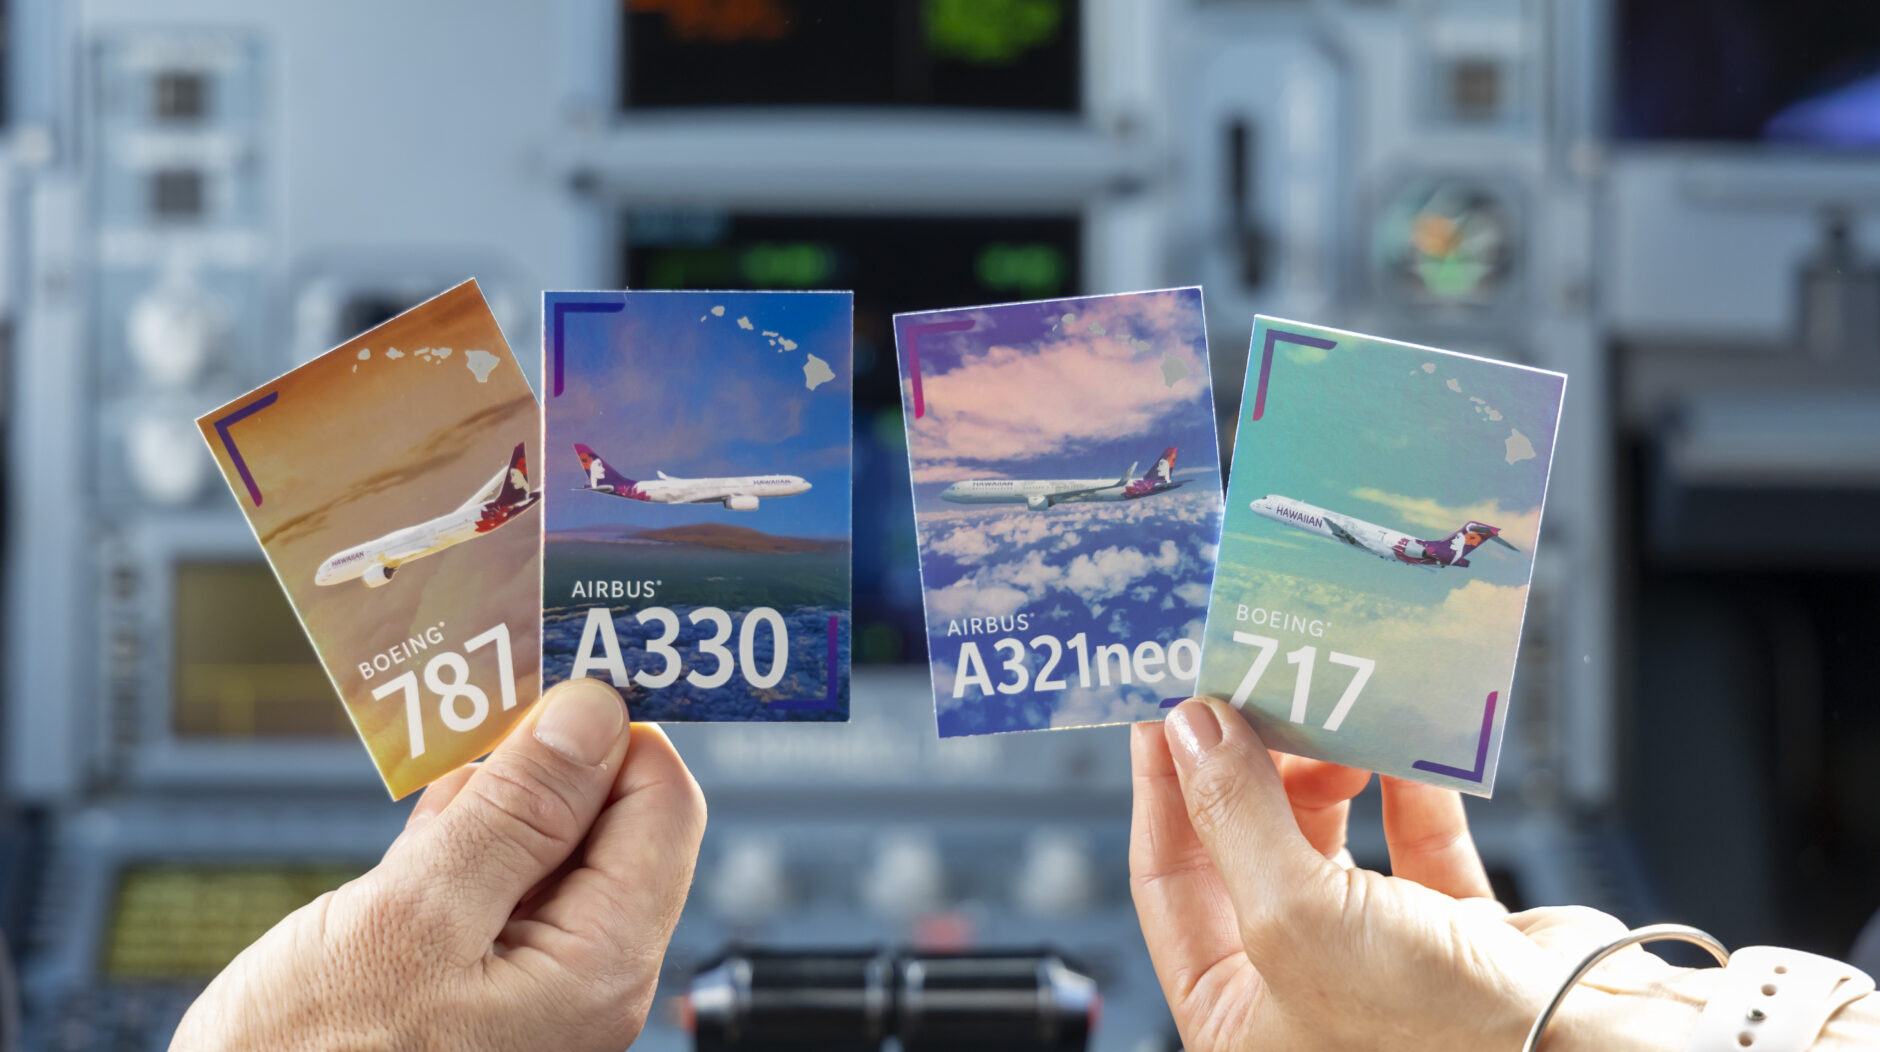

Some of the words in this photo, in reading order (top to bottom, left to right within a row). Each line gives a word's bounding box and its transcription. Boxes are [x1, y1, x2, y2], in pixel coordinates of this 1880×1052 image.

[1276, 506, 1323, 528] HAWAIIAN
[331, 551, 365, 567] HAWAIIAN
[570, 606, 789, 689] A330
[952, 632, 1202, 698] A321neo
[1229, 630, 1376, 732] 717
[371, 622, 518, 760] 787
